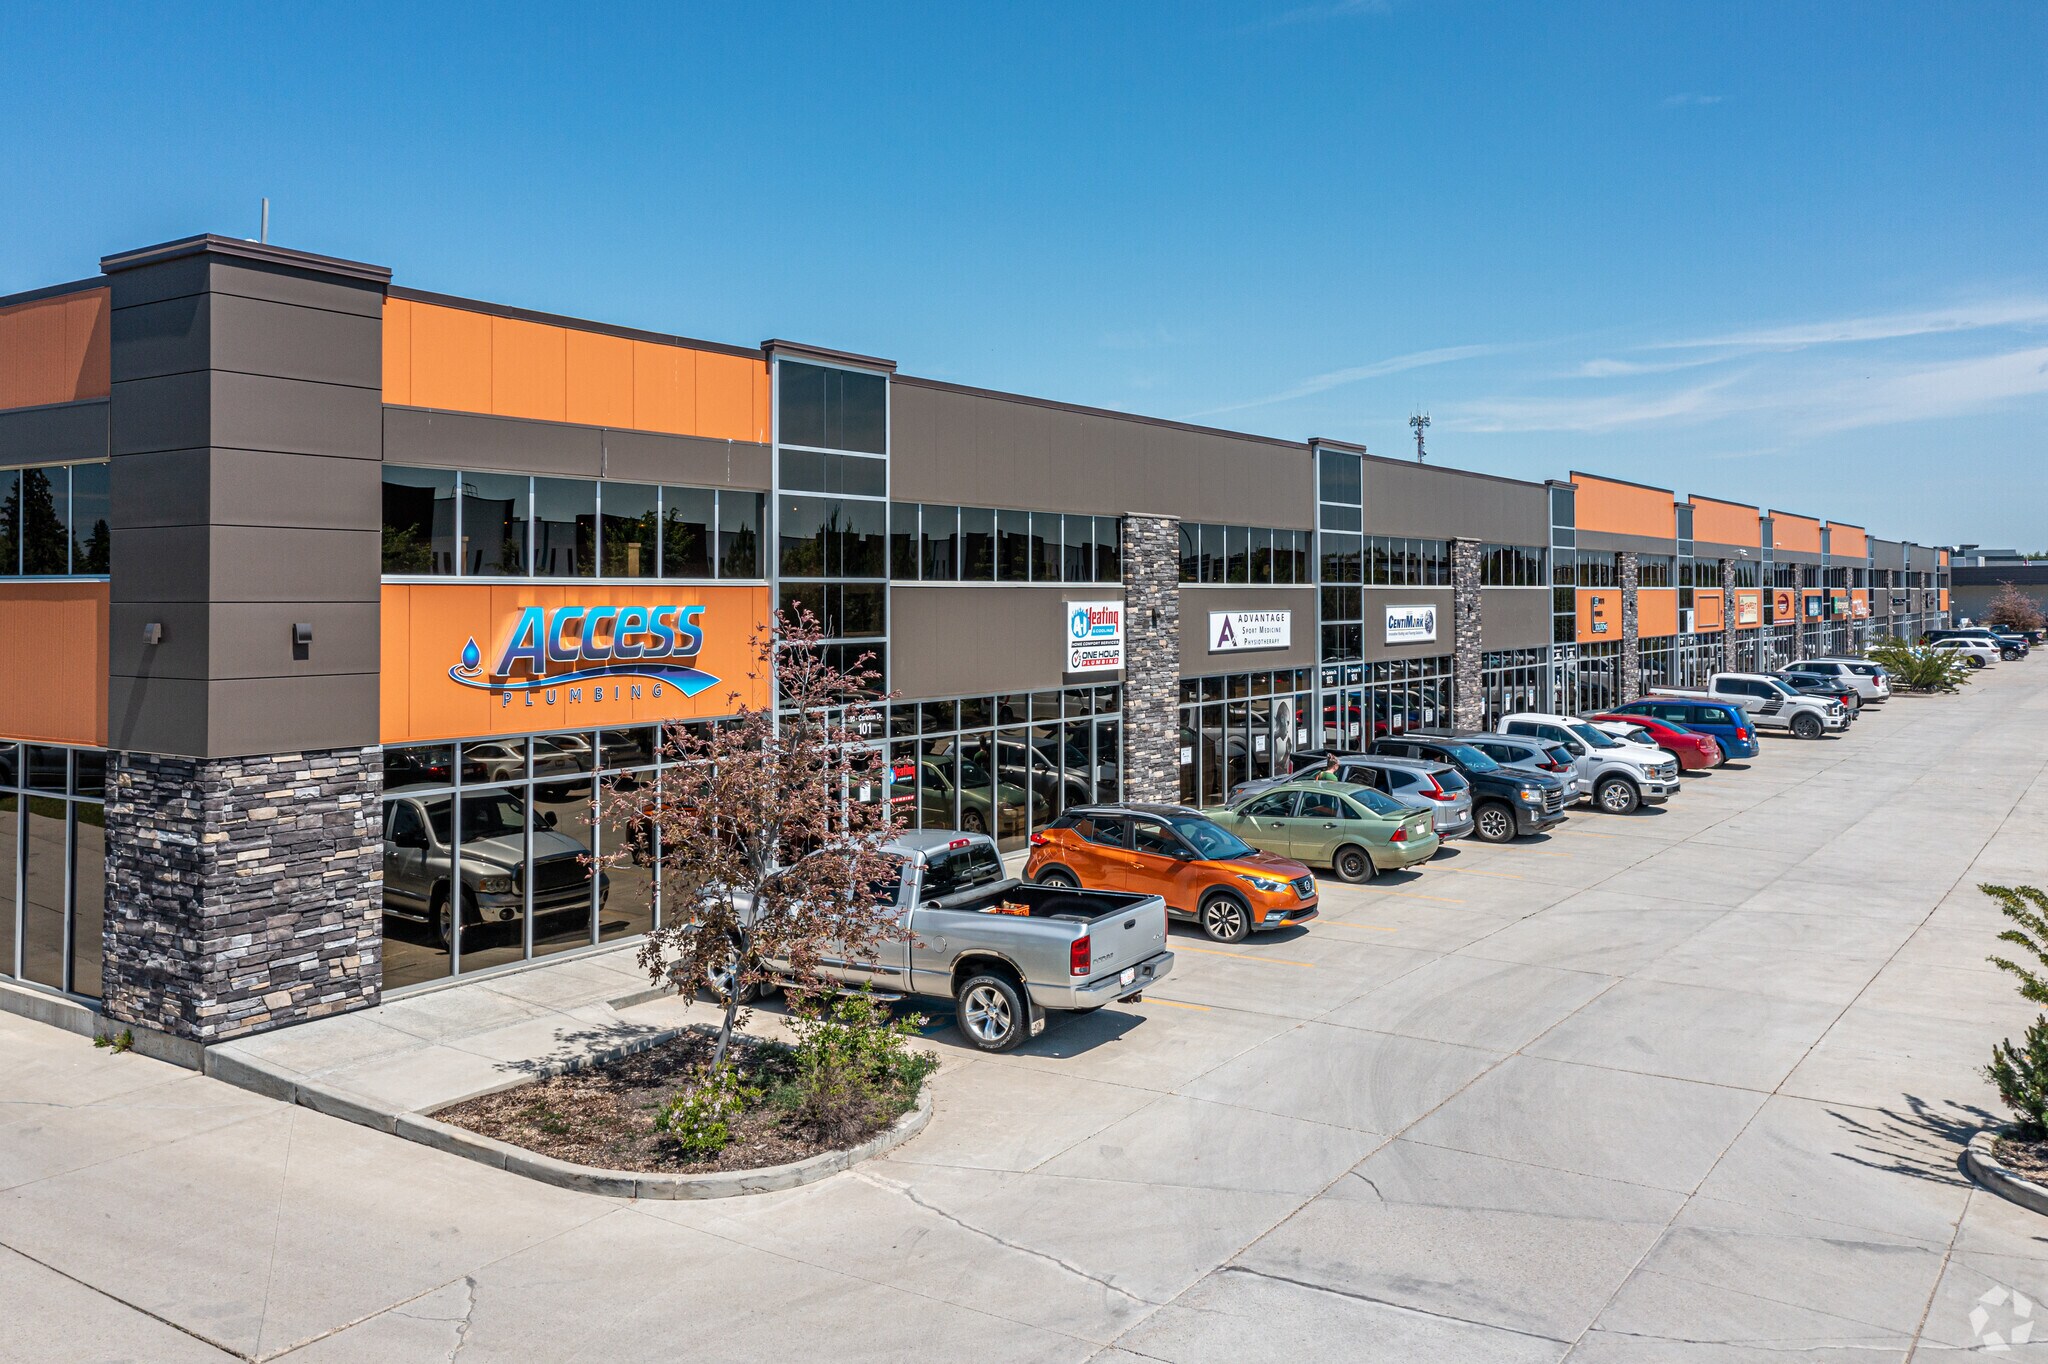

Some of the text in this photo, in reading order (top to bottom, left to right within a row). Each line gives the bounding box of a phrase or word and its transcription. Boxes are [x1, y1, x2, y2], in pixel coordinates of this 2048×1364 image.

[1085, 606, 1118, 633] Heating
[1238, 613, 1285, 623] ADVANTAGE
[1082, 650, 1119, 659] ONE HOUR
[1083, 658, 1118, 666] PLUMBING
[502, 683, 663, 707] PLUMBING
[858, 722, 872, 735] 101
